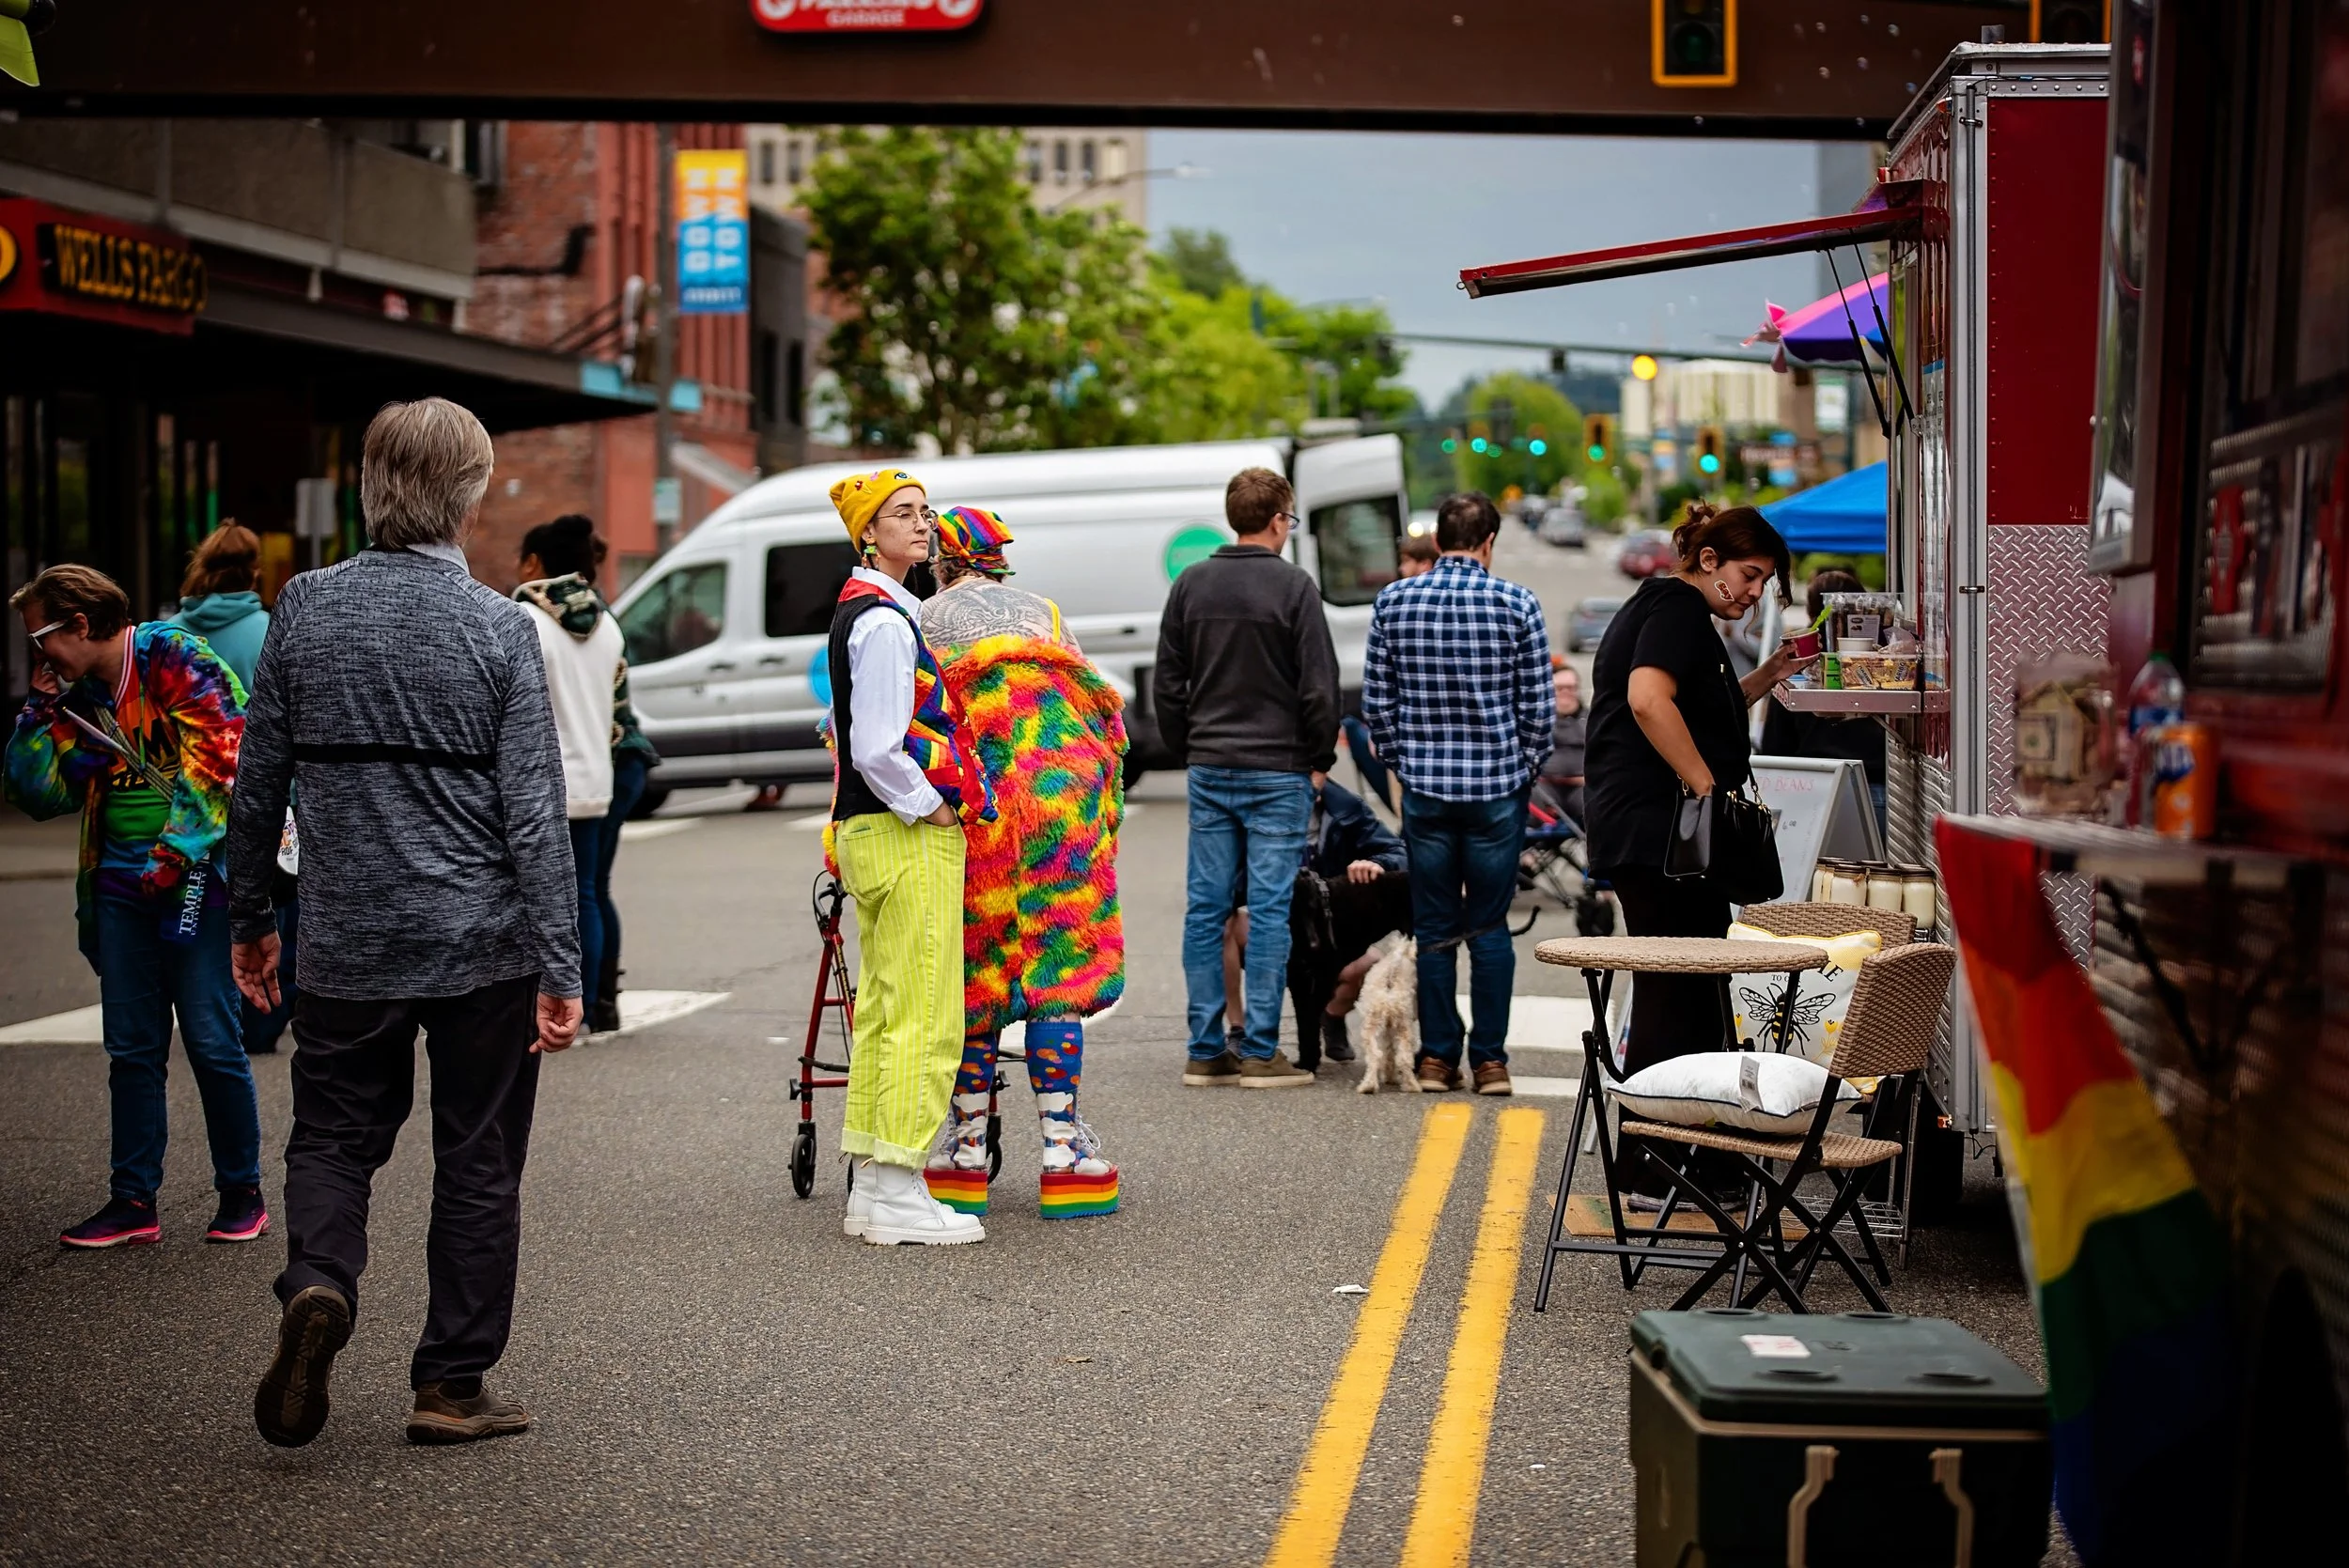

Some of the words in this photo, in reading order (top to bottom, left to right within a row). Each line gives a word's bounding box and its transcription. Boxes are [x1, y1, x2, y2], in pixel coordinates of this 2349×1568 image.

[683, 168, 711, 273] DOWN
[713, 168, 741, 272] TOWN
[54, 224, 134, 300] WELLS
[137, 241, 209, 314] FARGO
[1775, 776, 1815, 791] BEANS
[179, 871, 202, 934] TEMPLE
[191, 872, 207, 936] UNIVERSITY
